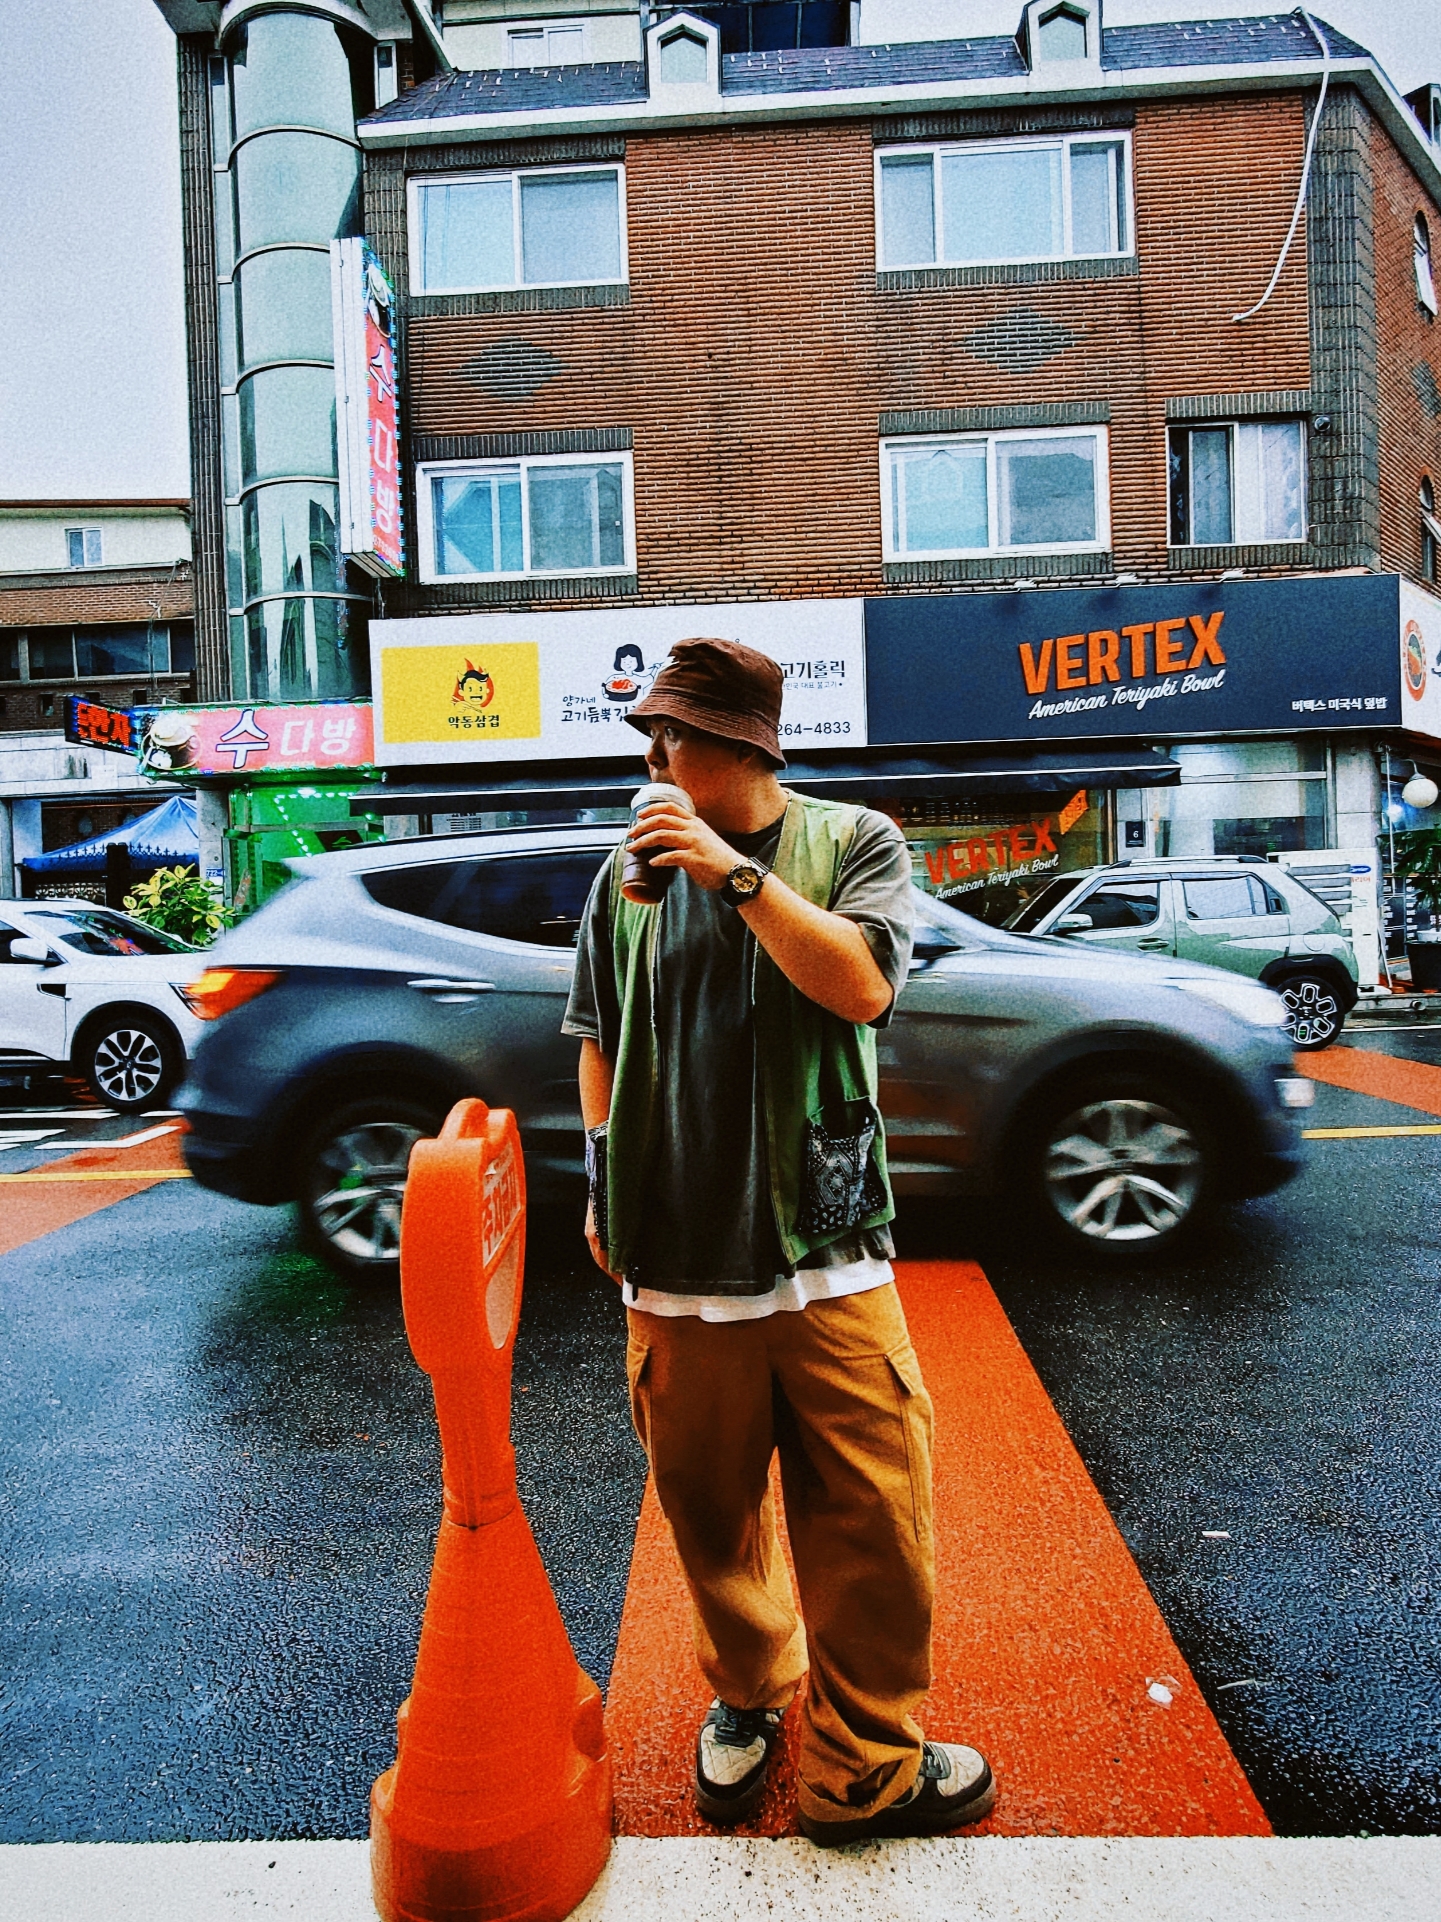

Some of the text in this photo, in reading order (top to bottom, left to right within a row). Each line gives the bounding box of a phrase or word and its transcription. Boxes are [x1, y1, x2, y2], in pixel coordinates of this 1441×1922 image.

[1018, 611, 1226, 694] VERTEX
[780, 660, 845, 678] 고기홀릭
[562, 695, 596, 706] 양가네
[1028, 669, 1226, 719] American Teriyaki Bowl
[1292, 697, 1388, 712] 버텍스 미국식 덮밥
[561, 707, 611, 723] 고기듬뿍
[1132, 830, 1139, 838] 6
[924, 817, 1057, 885] VERTEX
[933, 854, 1059, 900] American Teriyaki Bowl
